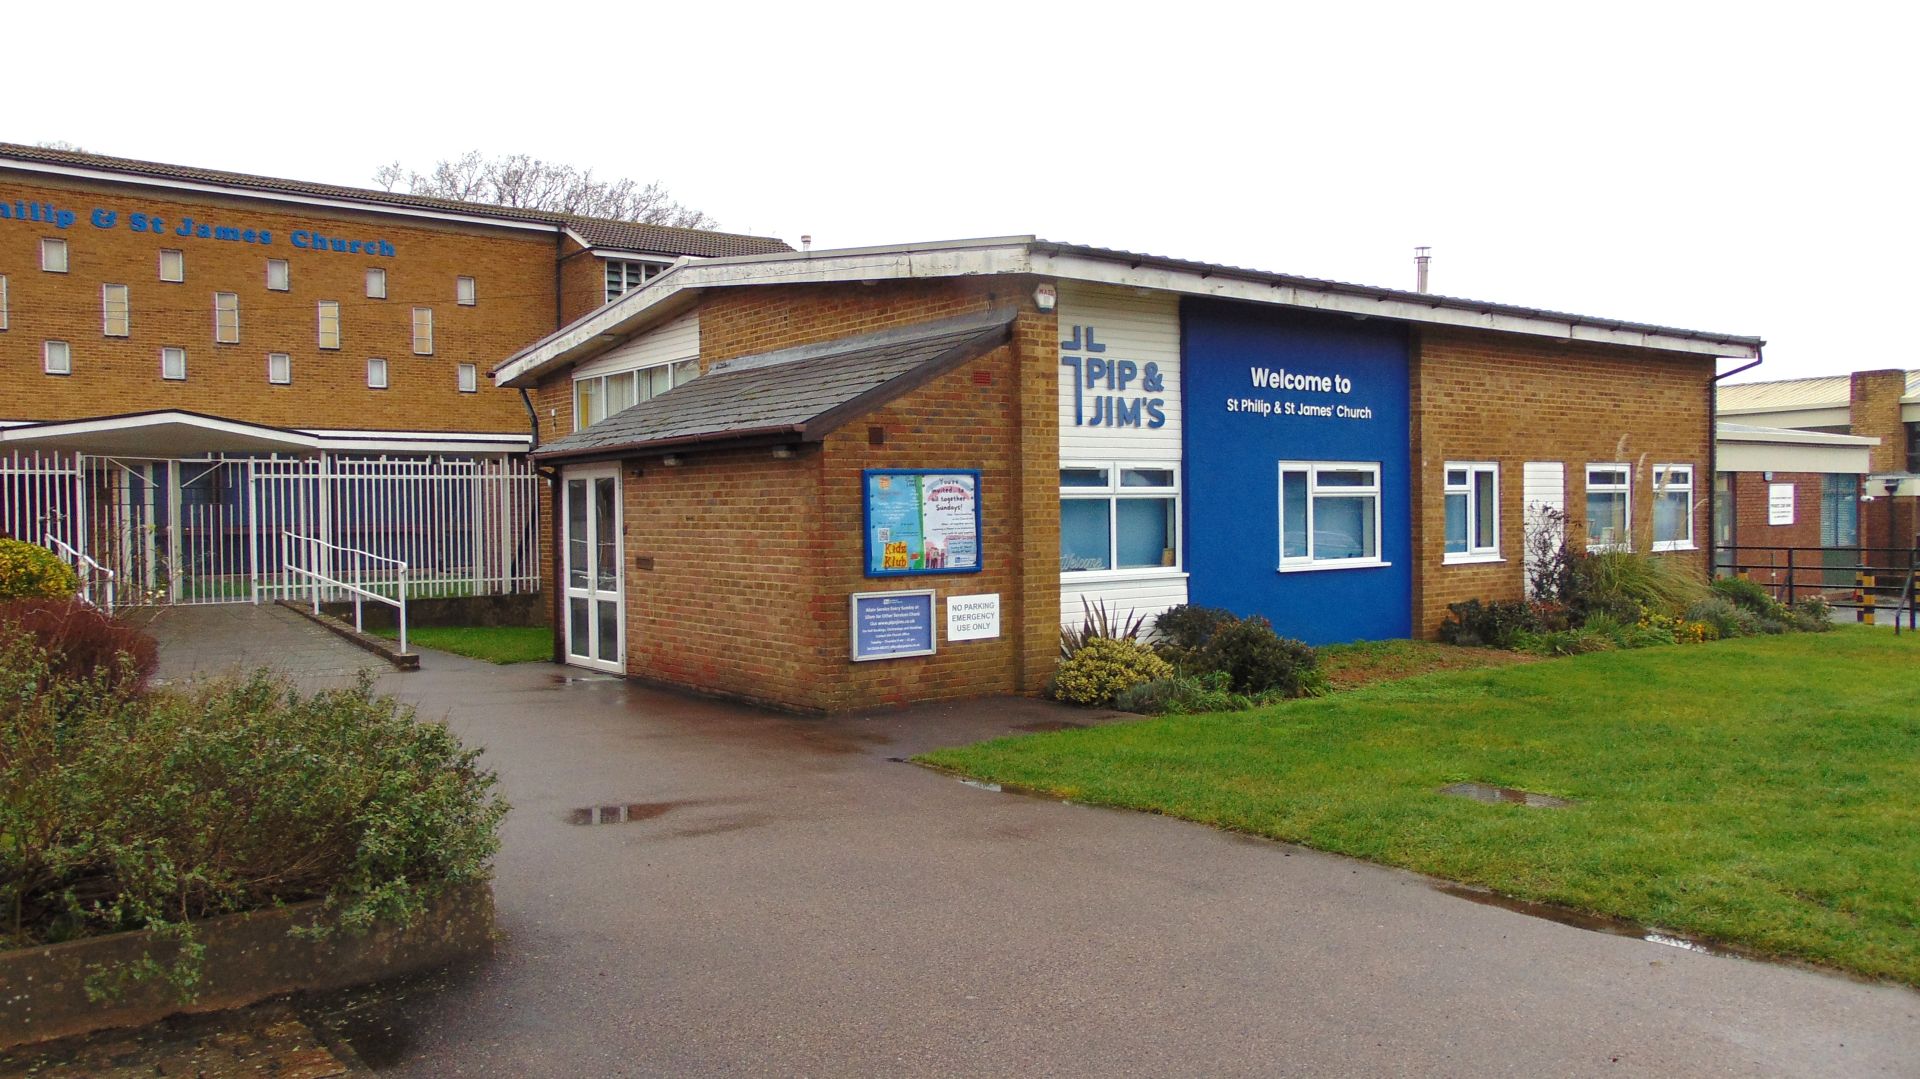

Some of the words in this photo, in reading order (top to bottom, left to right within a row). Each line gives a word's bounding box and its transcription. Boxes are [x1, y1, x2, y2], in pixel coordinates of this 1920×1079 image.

[91, 208, 118, 229] &
[130, 212, 165, 234] St
[176, 217, 273, 245] James
[290, 229, 396, 257] Church
[1086, 358, 1137, 390] PIP
[1143, 361, 1165, 392] &
[1251, 367, 1332, 392] Welcome
[1335, 374, 1351, 394] to
[1089, 395, 1166, 429] JIM'S
[1227, 398, 1238, 412] St
[1241, 399, 1271, 417] Philip
[1274, 401, 1282, 415] &
[1284, 402, 1295, 415] St
[1337, 405, 1372, 419] Church
[941, 496, 966, 504] together
[936, 504, 963, 512] Sundays!
[884, 555, 907, 567] Klub
[964, 602, 995, 610] PARKING
[952, 612, 995, 622] EMERGENCY
[957, 624, 971, 632] USE
[972, 622, 991, 631] ONLY
